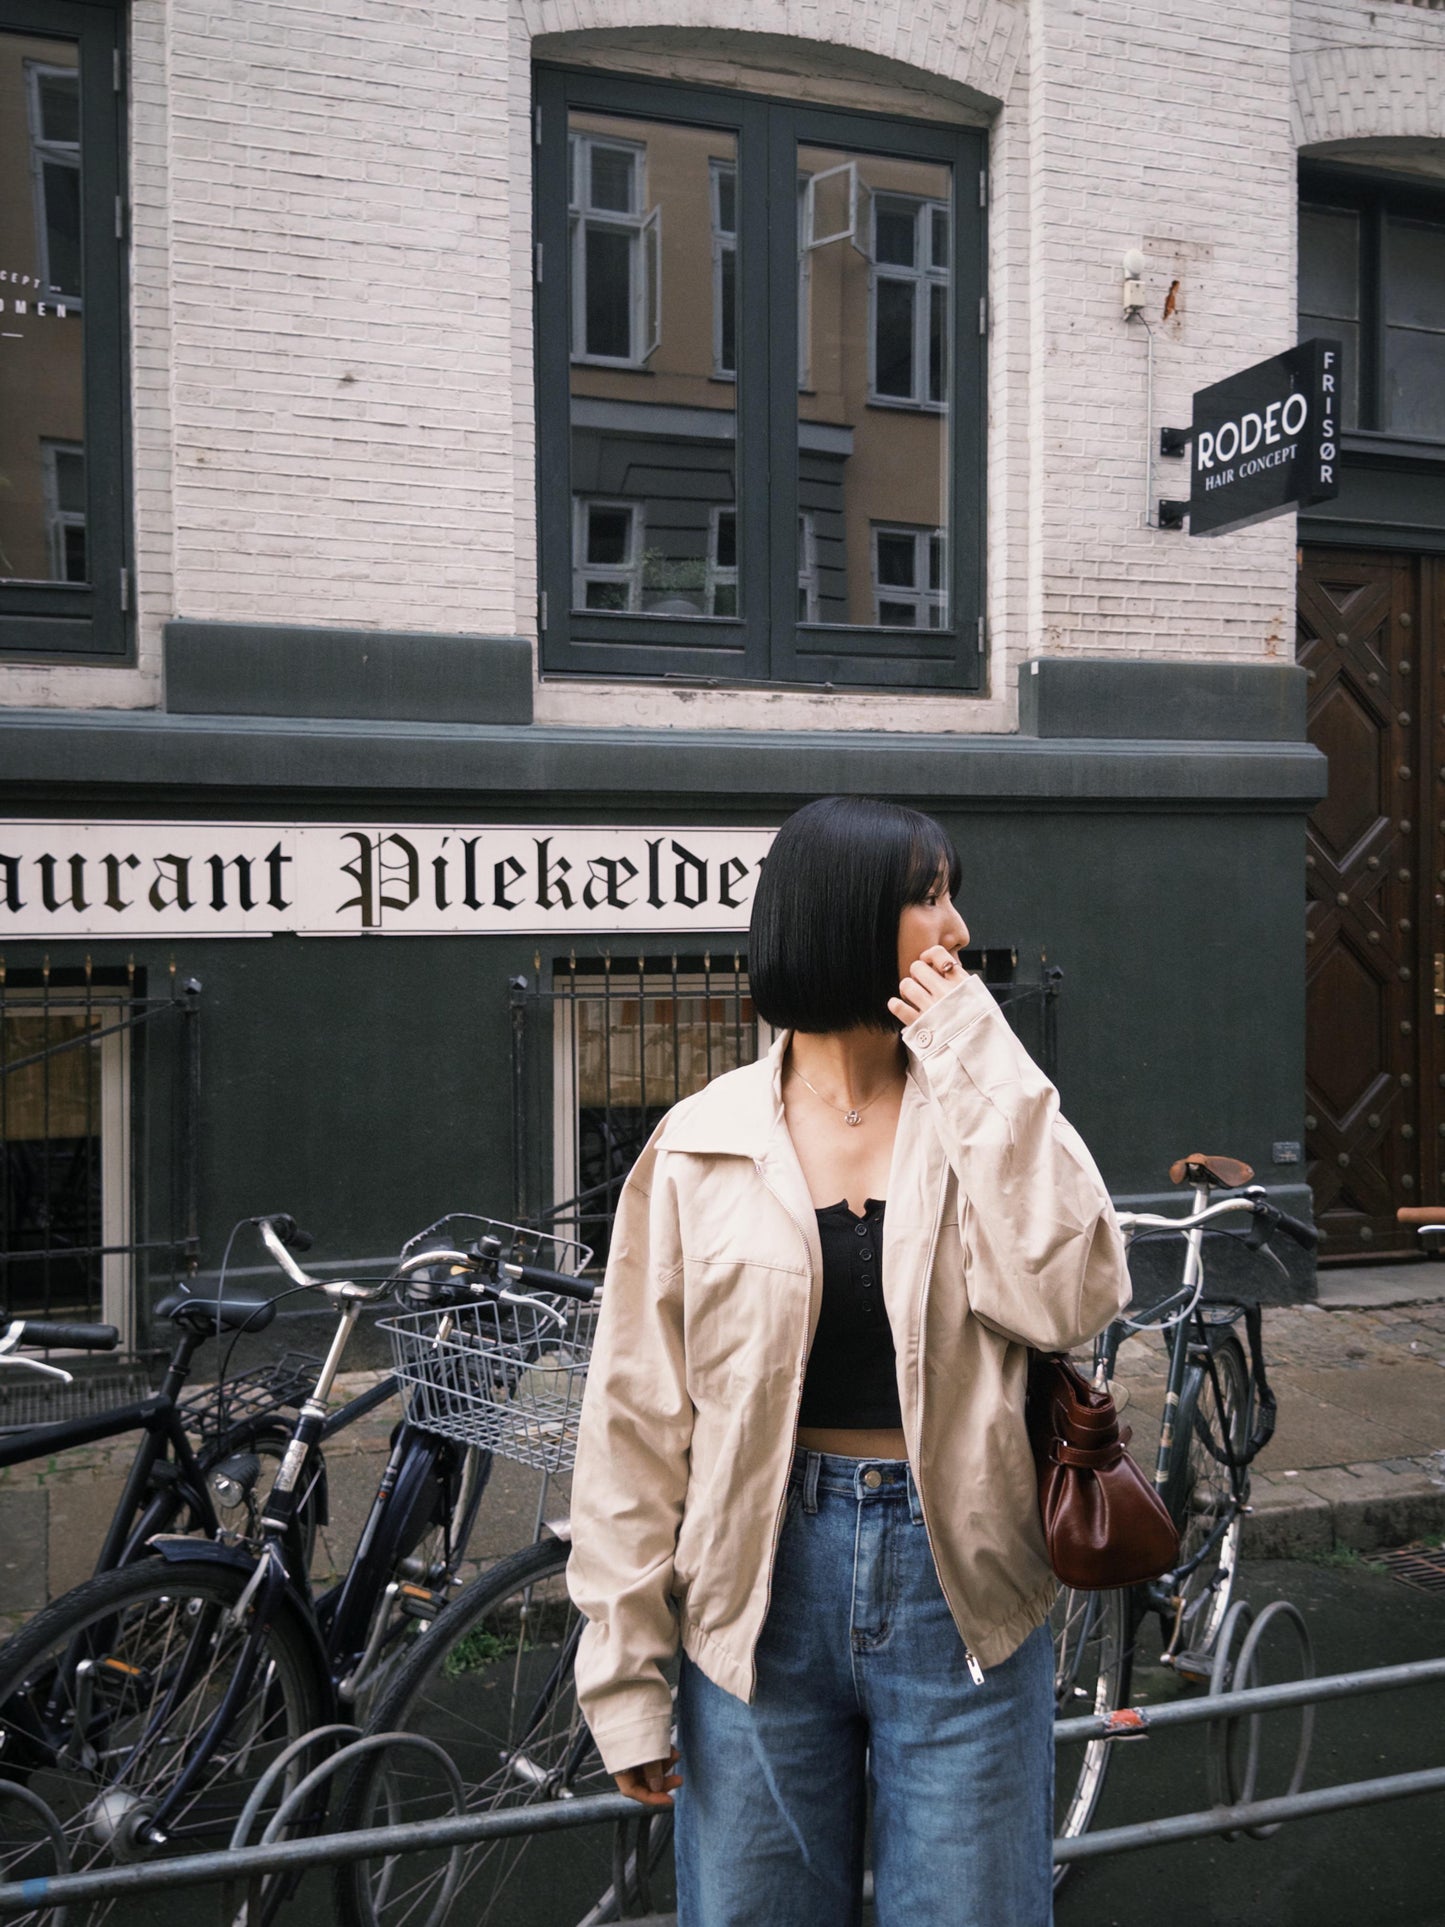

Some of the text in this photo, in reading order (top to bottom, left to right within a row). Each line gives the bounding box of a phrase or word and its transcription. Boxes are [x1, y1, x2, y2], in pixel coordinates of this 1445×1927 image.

[1198, 393, 1307, 471] RODEO
[1319, 352, 1336, 483] FRISØR
[1205, 444, 1297, 491] HAIR CONCEPT
[336, 831, 767, 928] Pilekælde
